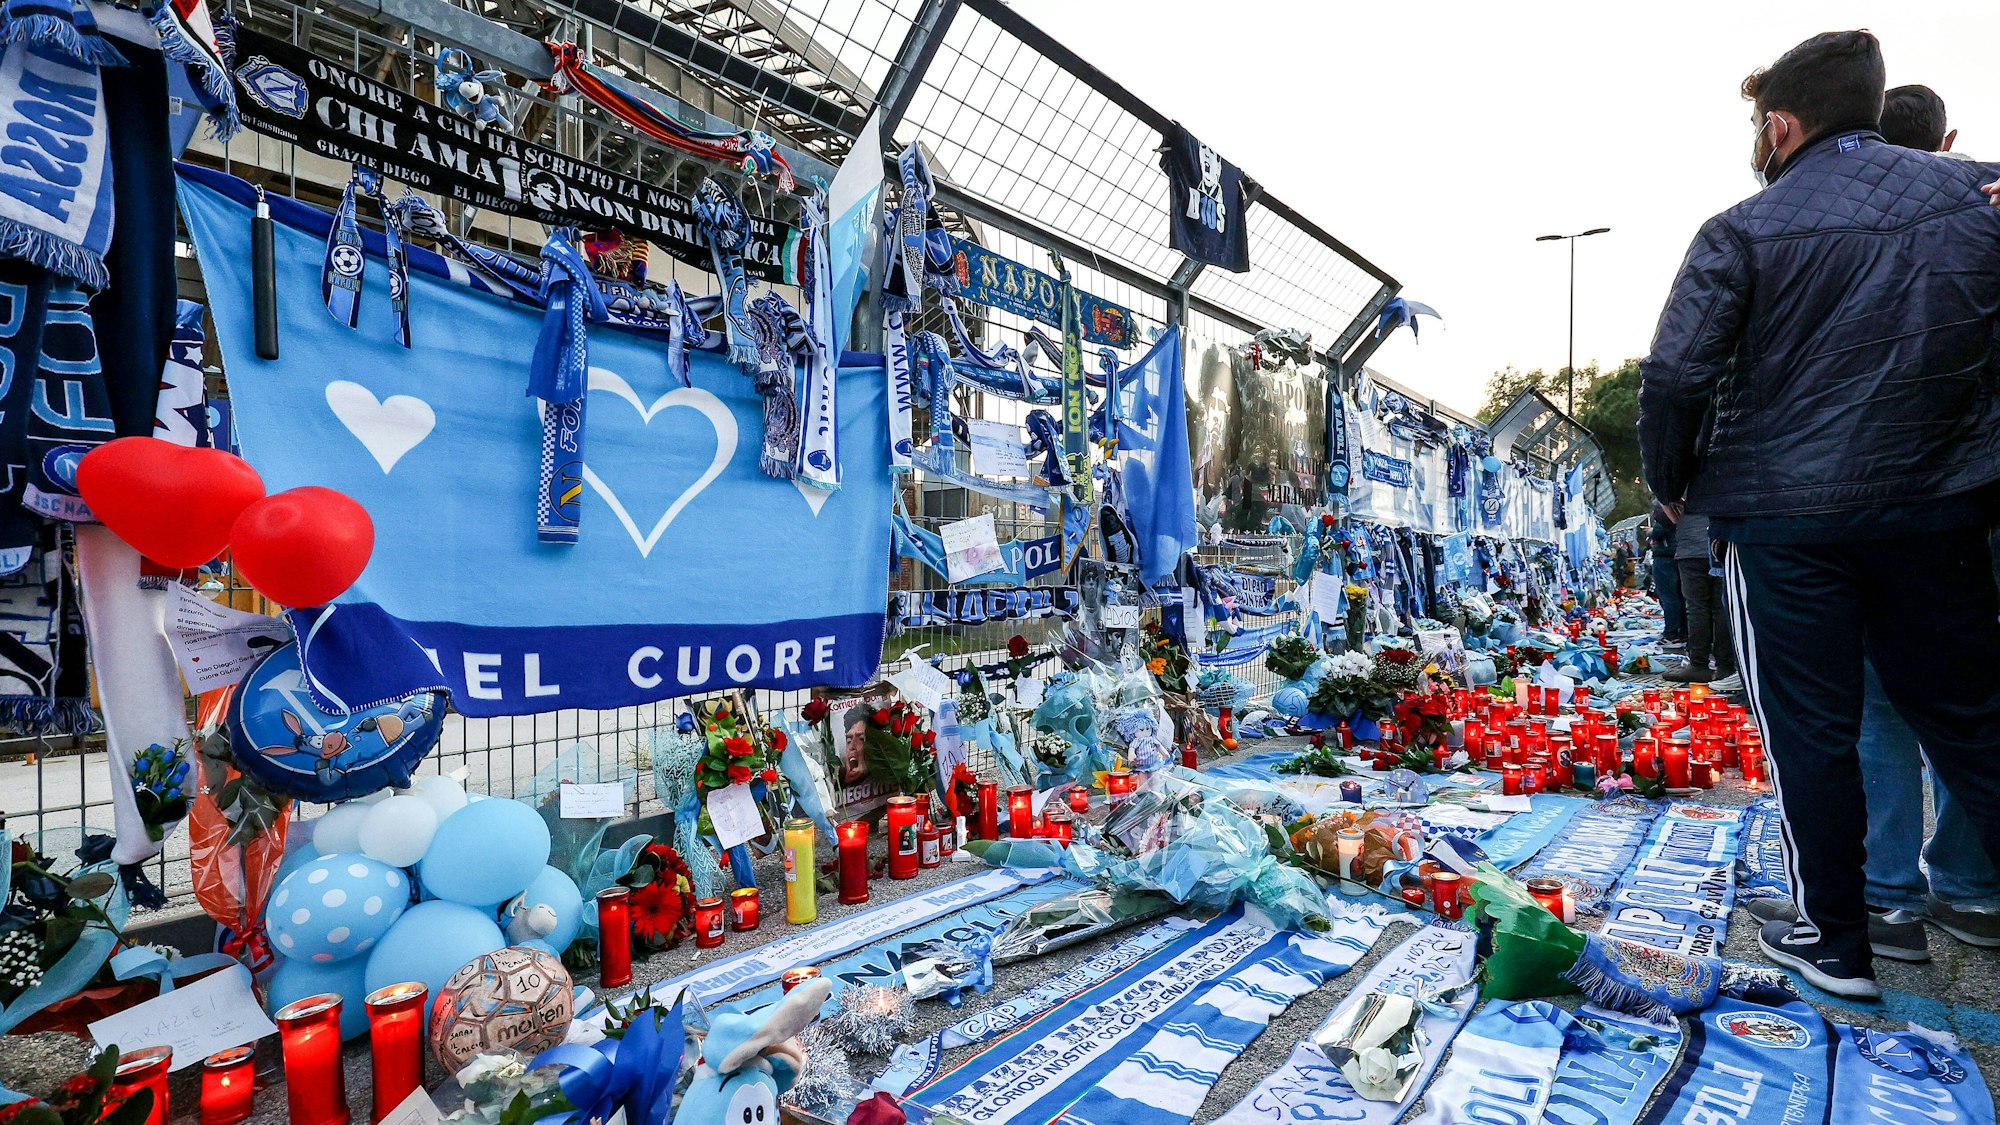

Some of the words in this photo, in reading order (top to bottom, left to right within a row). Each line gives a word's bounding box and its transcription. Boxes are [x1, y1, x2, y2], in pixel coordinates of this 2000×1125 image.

[308, 58, 403, 113] ONORE
[412, 104, 430, 125] A
[437, 114, 482, 146] CHI
[488, 134, 520, 160] HA
[524, 147, 613, 192] SCRITTO
[617, 176, 640, 198] LA
[646, 188, 691, 215] NOST
[316, 96, 398, 150] CHI
[569, 185, 634, 224] NON
[316, 139, 378, 169] GRAZIE
[382, 161, 431, 187] DIEGO
[475, 190, 520, 214] DIEGO
[628, 635, 837, 689] CUORE
[516, 973, 541, 994] 10
[496, 1002, 565, 1043] molten
[455, 1041, 485, 1056] CALCIO
[972, 1071, 1049, 1123] GLORIOSI
[1044, 1039, 1099, 1077] NOSTRI
